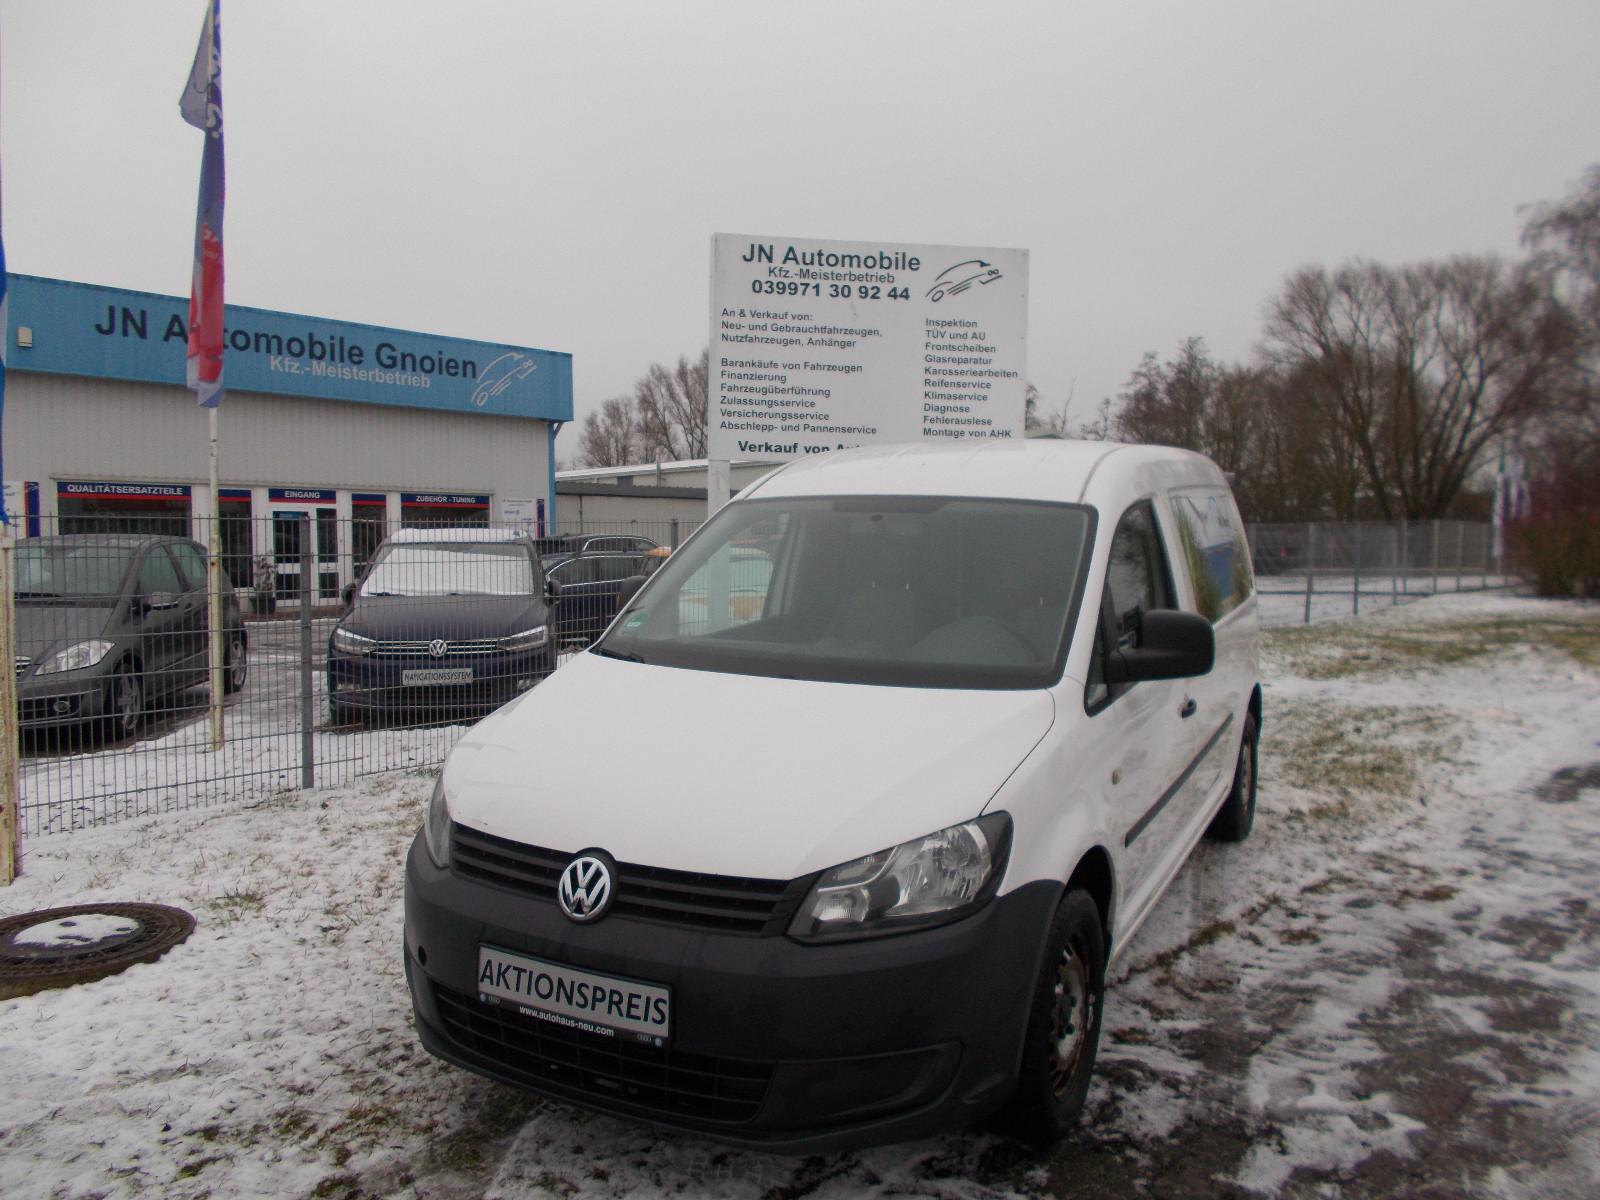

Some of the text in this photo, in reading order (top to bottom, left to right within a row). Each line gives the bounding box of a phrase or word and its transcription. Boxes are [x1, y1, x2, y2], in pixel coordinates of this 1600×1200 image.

[742, 243, 921, 272] JN Automobile
[768, 266, 895, 284] Kfz.-Meisterbetrieb
[752, 279, 910, 301] 039971 30 92 44
[721, 308, 814, 321] An & Verkauf von:
[721, 320, 883, 338] Neu- und Gebrauchtfahrzeugen,
[925, 318, 978, 329] Inspektion
[925, 328, 986, 341] TÜV und AU
[95, 304, 148, 340] JN
[375, 342, 477, 380] Gnoien
[721, 333, 857, 350] Nutzfahrzeugen, Anhänger
[925, 342, 996, 353] Frontscheiben
[721, 358, 863, 374] Barankäufe von Fahrzeugen
[925, 354, 993, 366] Glasreparatur
[269, 355, 431, 389] Kfz.-Meisterbetrieb
[721, 371, 787, 384] Finanzierung
[924, 366, 1018, 378] Karosseriearbeiten
[720, 383, 831, 398] Fahrzeugüberführung
[924, 379, 992, 389] Reifenservice
[720, 396, 816, 409] Zulassungsservice
[924, 391, 988, 402] Klimaservice
[923, 403, 971, 414] Diagnose
[720, 409, 830, 422] Versicherungsservice
[923, 415, 993, 426] Fehlerauslese
[720, 421, 877, 435] Abschlepp- und Pannenservice
[923, 427, 1012, 439] Montage von AHK
[738, 440, 798, 454] Verkauf
[804, 444, 830, 454] von
[67, 484, 183, 495] QUALITÄTSERSATZTEILE
[284, 490, 321, 499] EINGANG
[416, 494, 447, 503] ZUBEHÖR
[452, 496, 476, 504] TUNING
[479, 958, 668, 1026] AKTIONSPREIS
[519, 1005, 615, 1038] www.autohaus-neu.com
